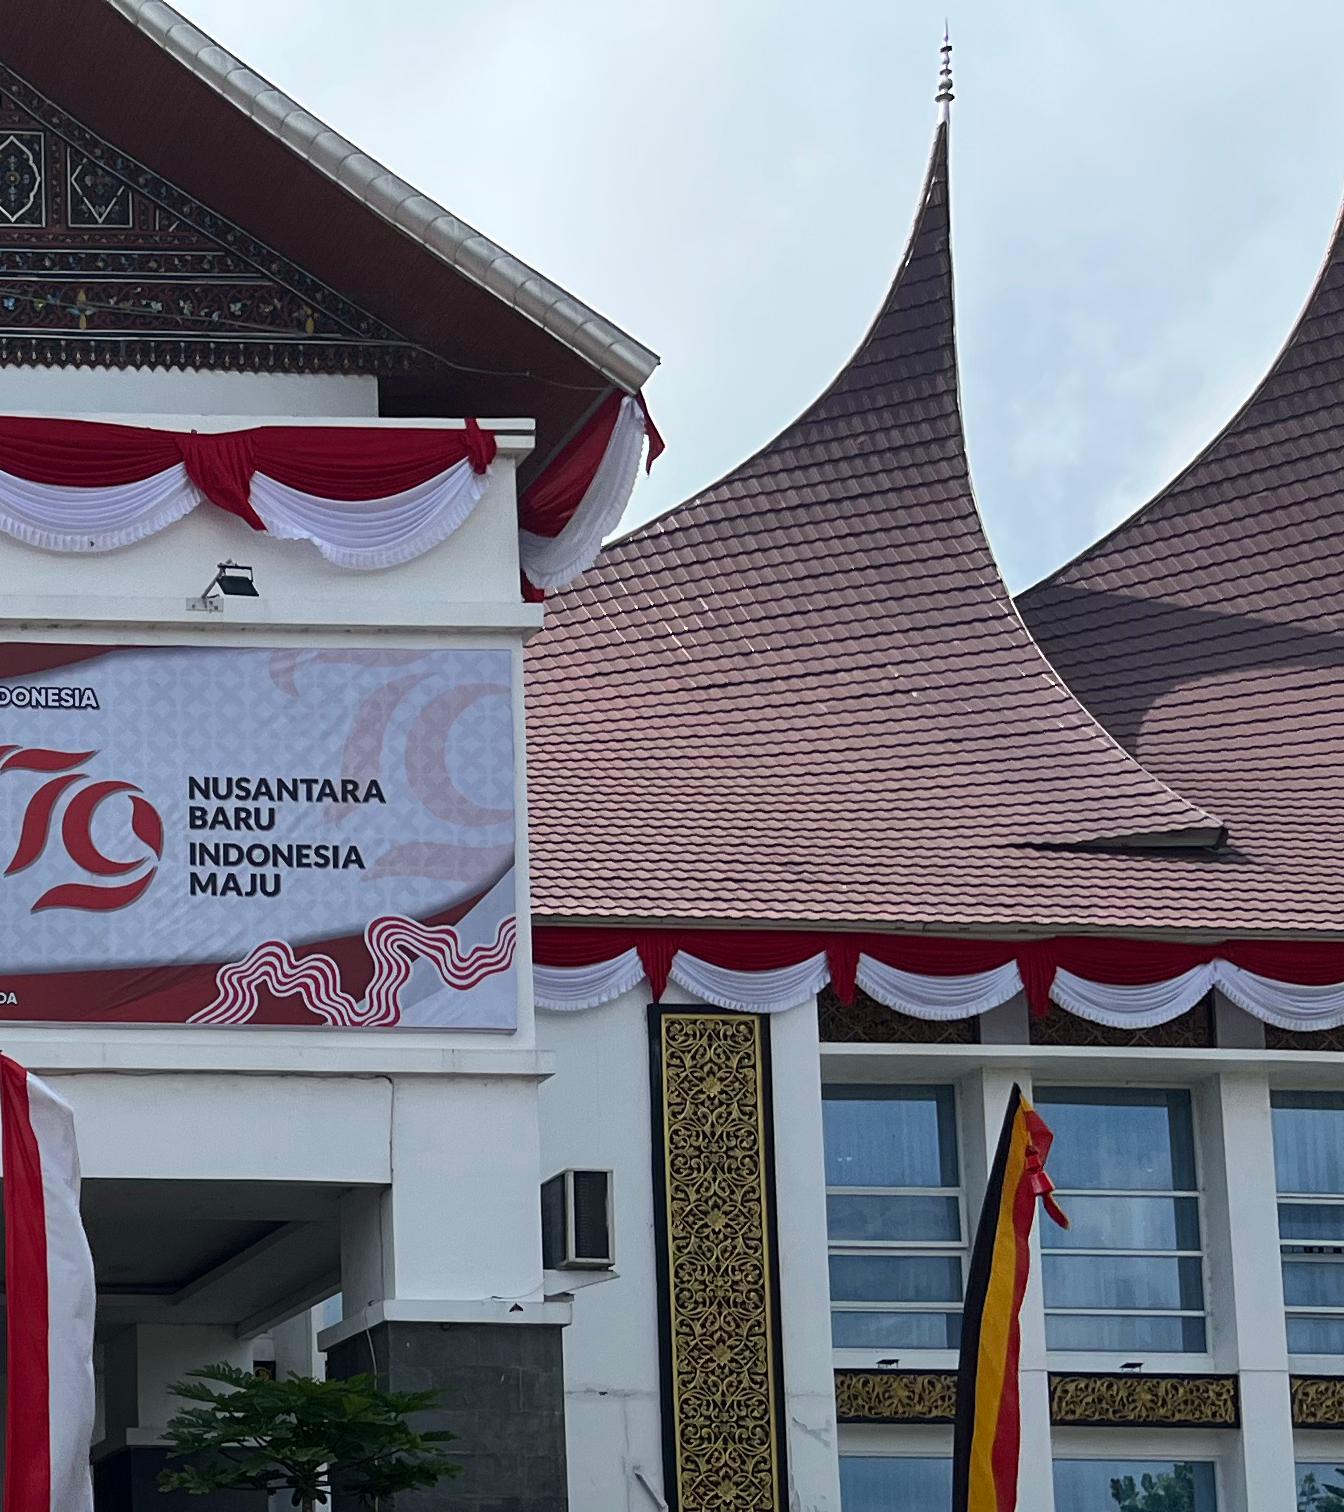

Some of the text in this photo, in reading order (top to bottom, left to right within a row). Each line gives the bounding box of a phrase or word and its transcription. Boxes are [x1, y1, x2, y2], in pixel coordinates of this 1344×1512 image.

[188, 775, 387, 804] NUSANTARA
[188, 806, 277, 832] BARU
[188, 843, 366, 870] INDONESIA
[188, 872, 283, 898] MAJU
